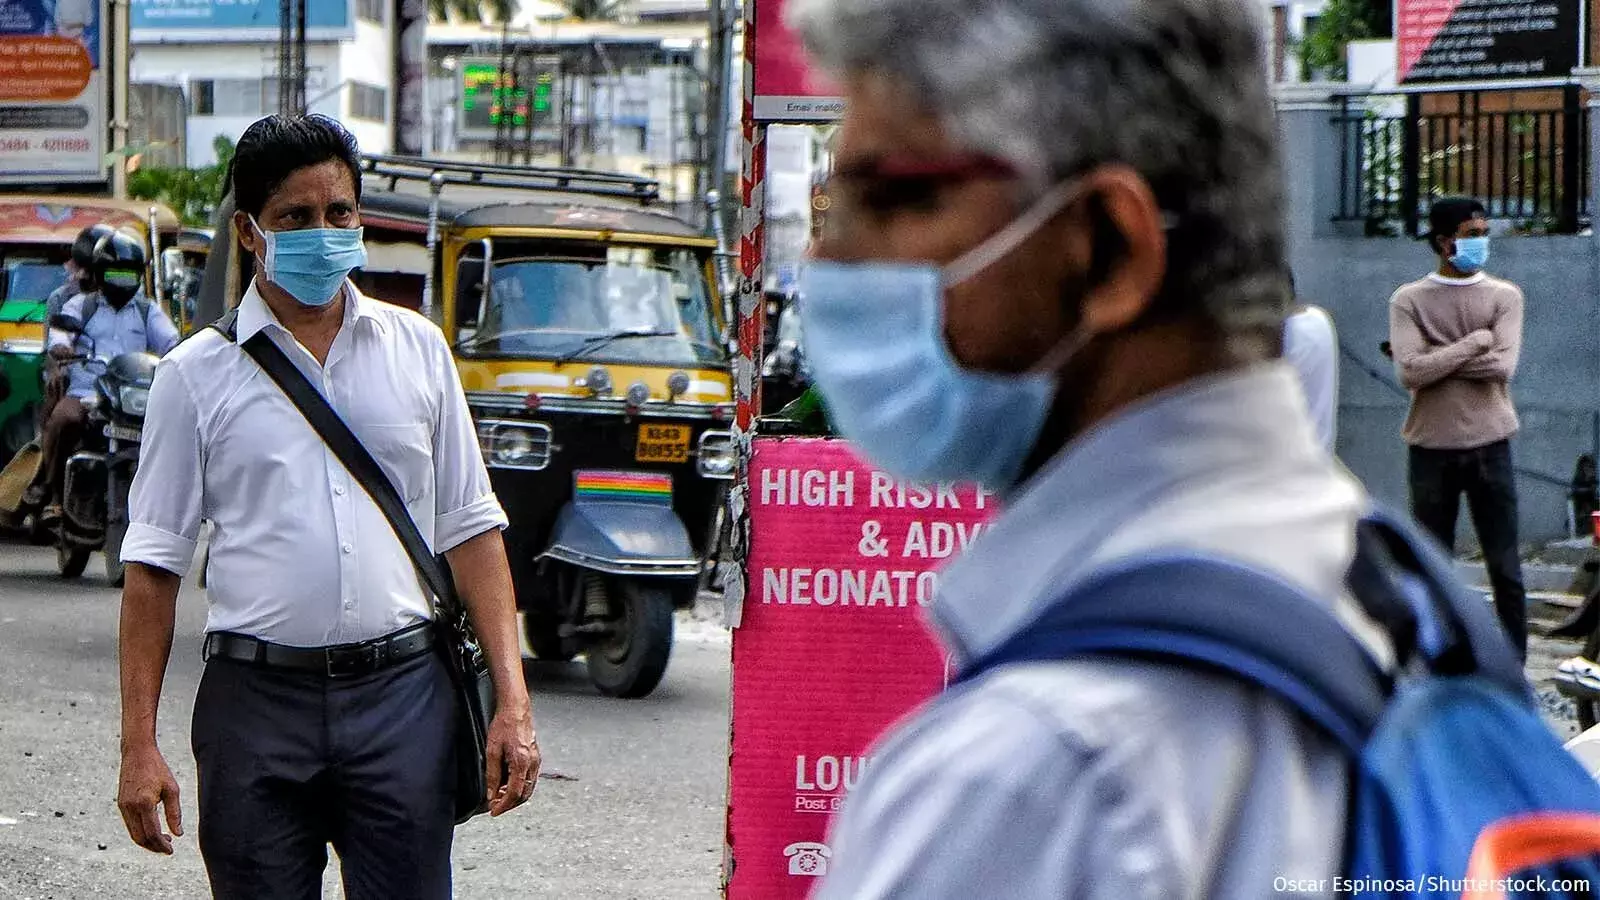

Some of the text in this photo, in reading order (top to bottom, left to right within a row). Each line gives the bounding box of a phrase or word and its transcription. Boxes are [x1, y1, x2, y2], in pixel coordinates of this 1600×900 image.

[761, 469, 854, 507] HIGH
[870, 472, 961, 509] RISK
[859, 520, 888, 557] &
[795, 797, 826, 810] Post
